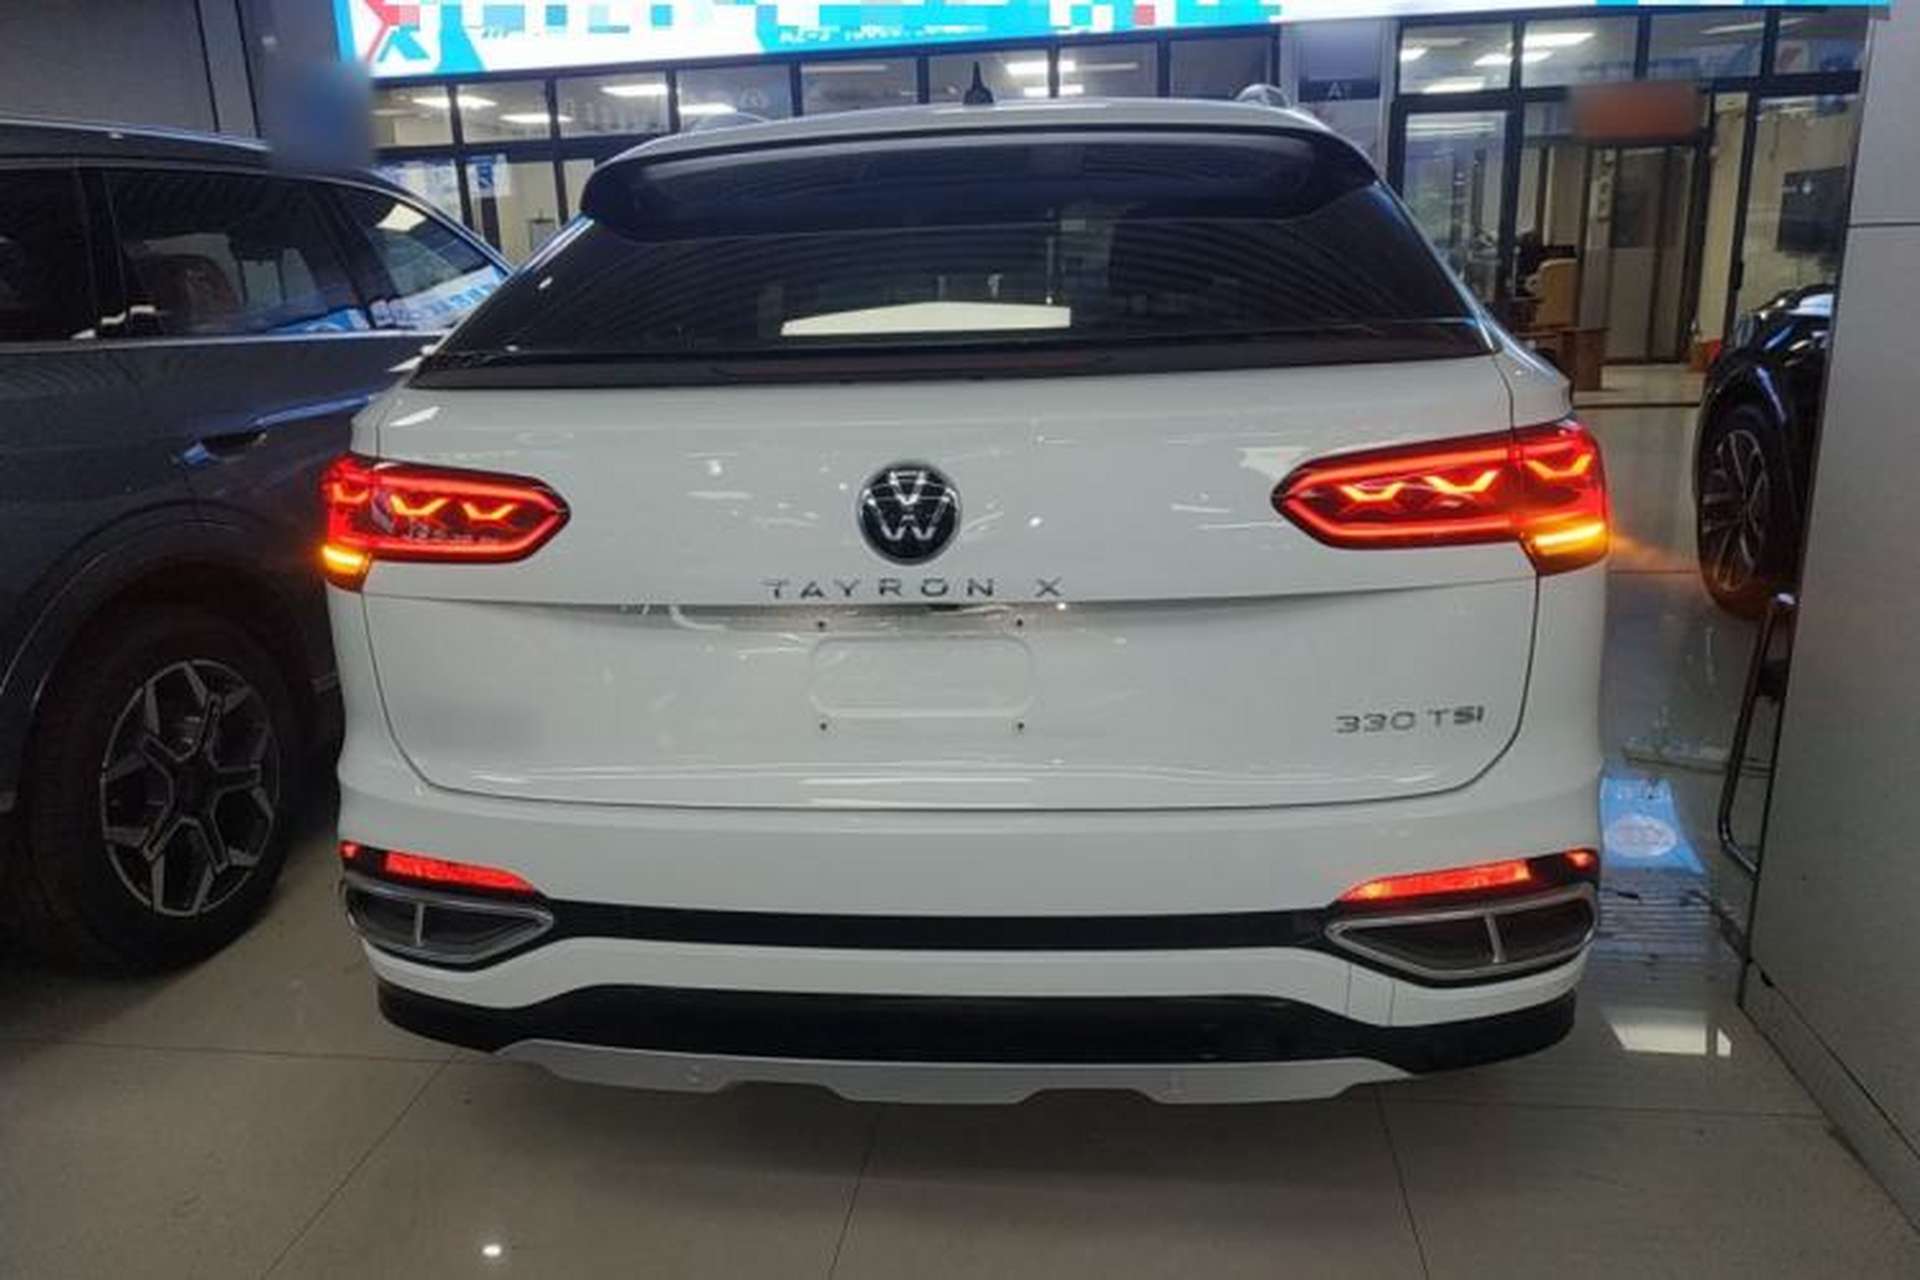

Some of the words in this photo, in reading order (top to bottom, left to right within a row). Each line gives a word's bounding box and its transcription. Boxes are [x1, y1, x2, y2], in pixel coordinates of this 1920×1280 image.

[762, 577, 995, 599] TAYRON
[1035, 576, 1064, 598] X
[1335, 711, 1416, 734] 330
[1426, 705, 1484, 727] TSI
